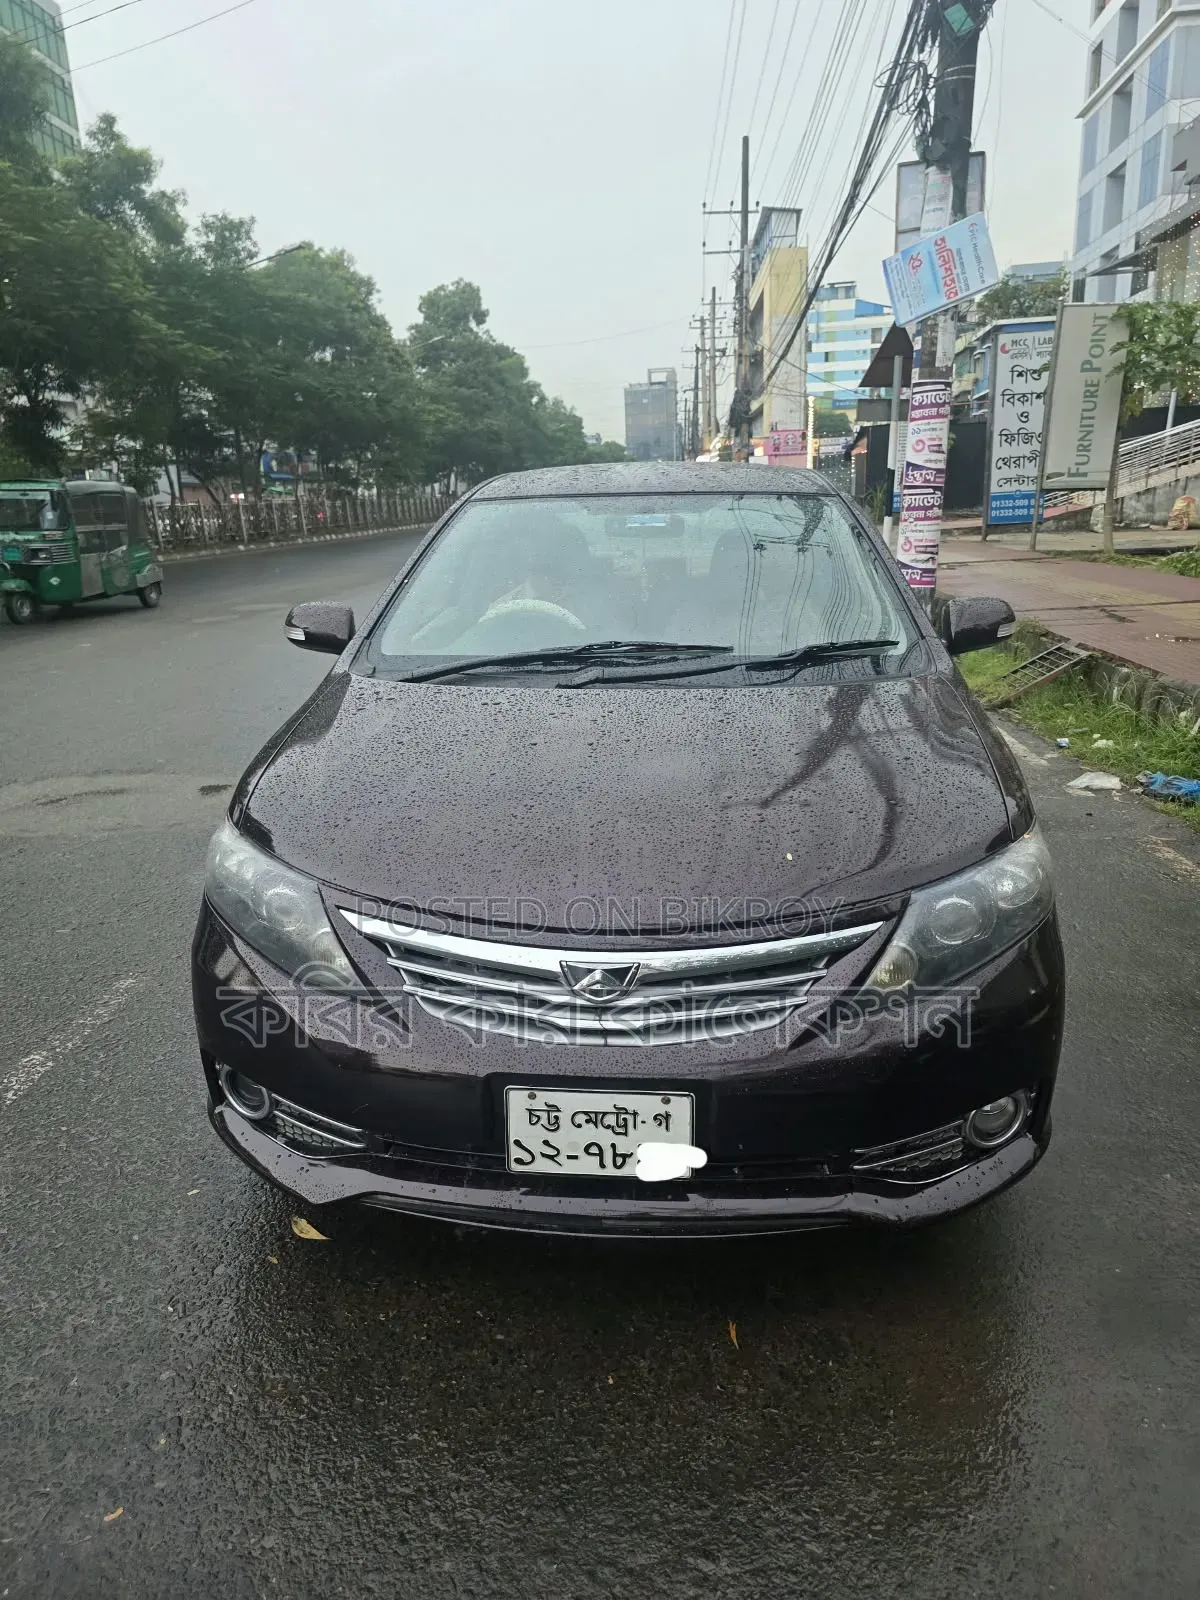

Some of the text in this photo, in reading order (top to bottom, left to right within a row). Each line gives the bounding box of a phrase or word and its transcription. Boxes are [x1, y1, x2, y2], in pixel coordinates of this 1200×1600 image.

[1011, 338, 1028, 347] MCC
[1067, 313, 1108, 478] FURNITURE POINT
[1016, 411, 1030, 423] ও
[525, 1101, 562, 1132] চট্ট
[513, 1139, 643, 1170] ১২-৭৮
